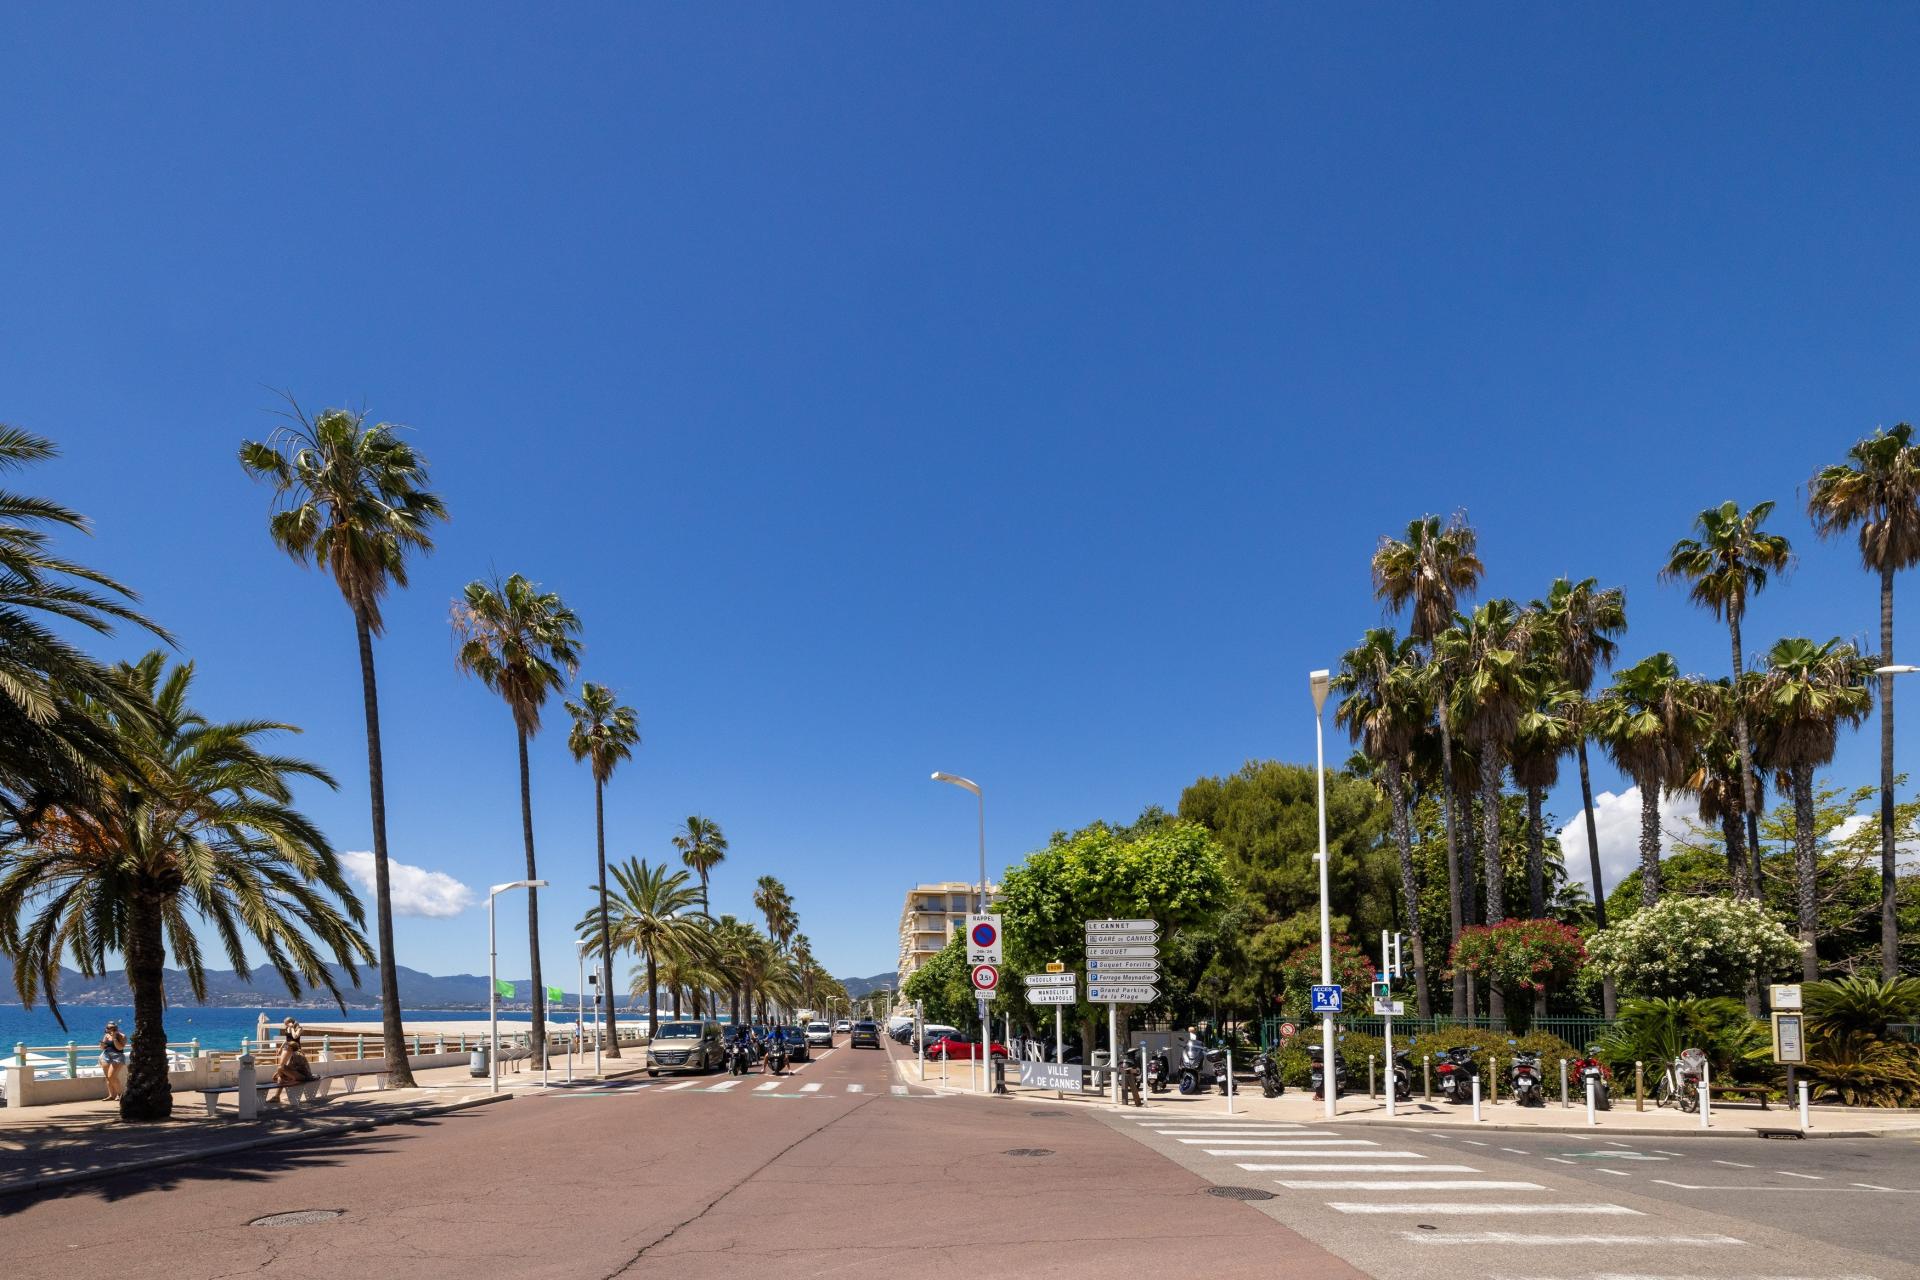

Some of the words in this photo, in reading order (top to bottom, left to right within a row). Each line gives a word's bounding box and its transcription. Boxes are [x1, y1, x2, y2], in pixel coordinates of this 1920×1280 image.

[1048, 1066, 1068, 1076] VILLE
[1037, 1077, 1047, 1086] DE
[1050, 1078, 1080, 1090] CANNES
